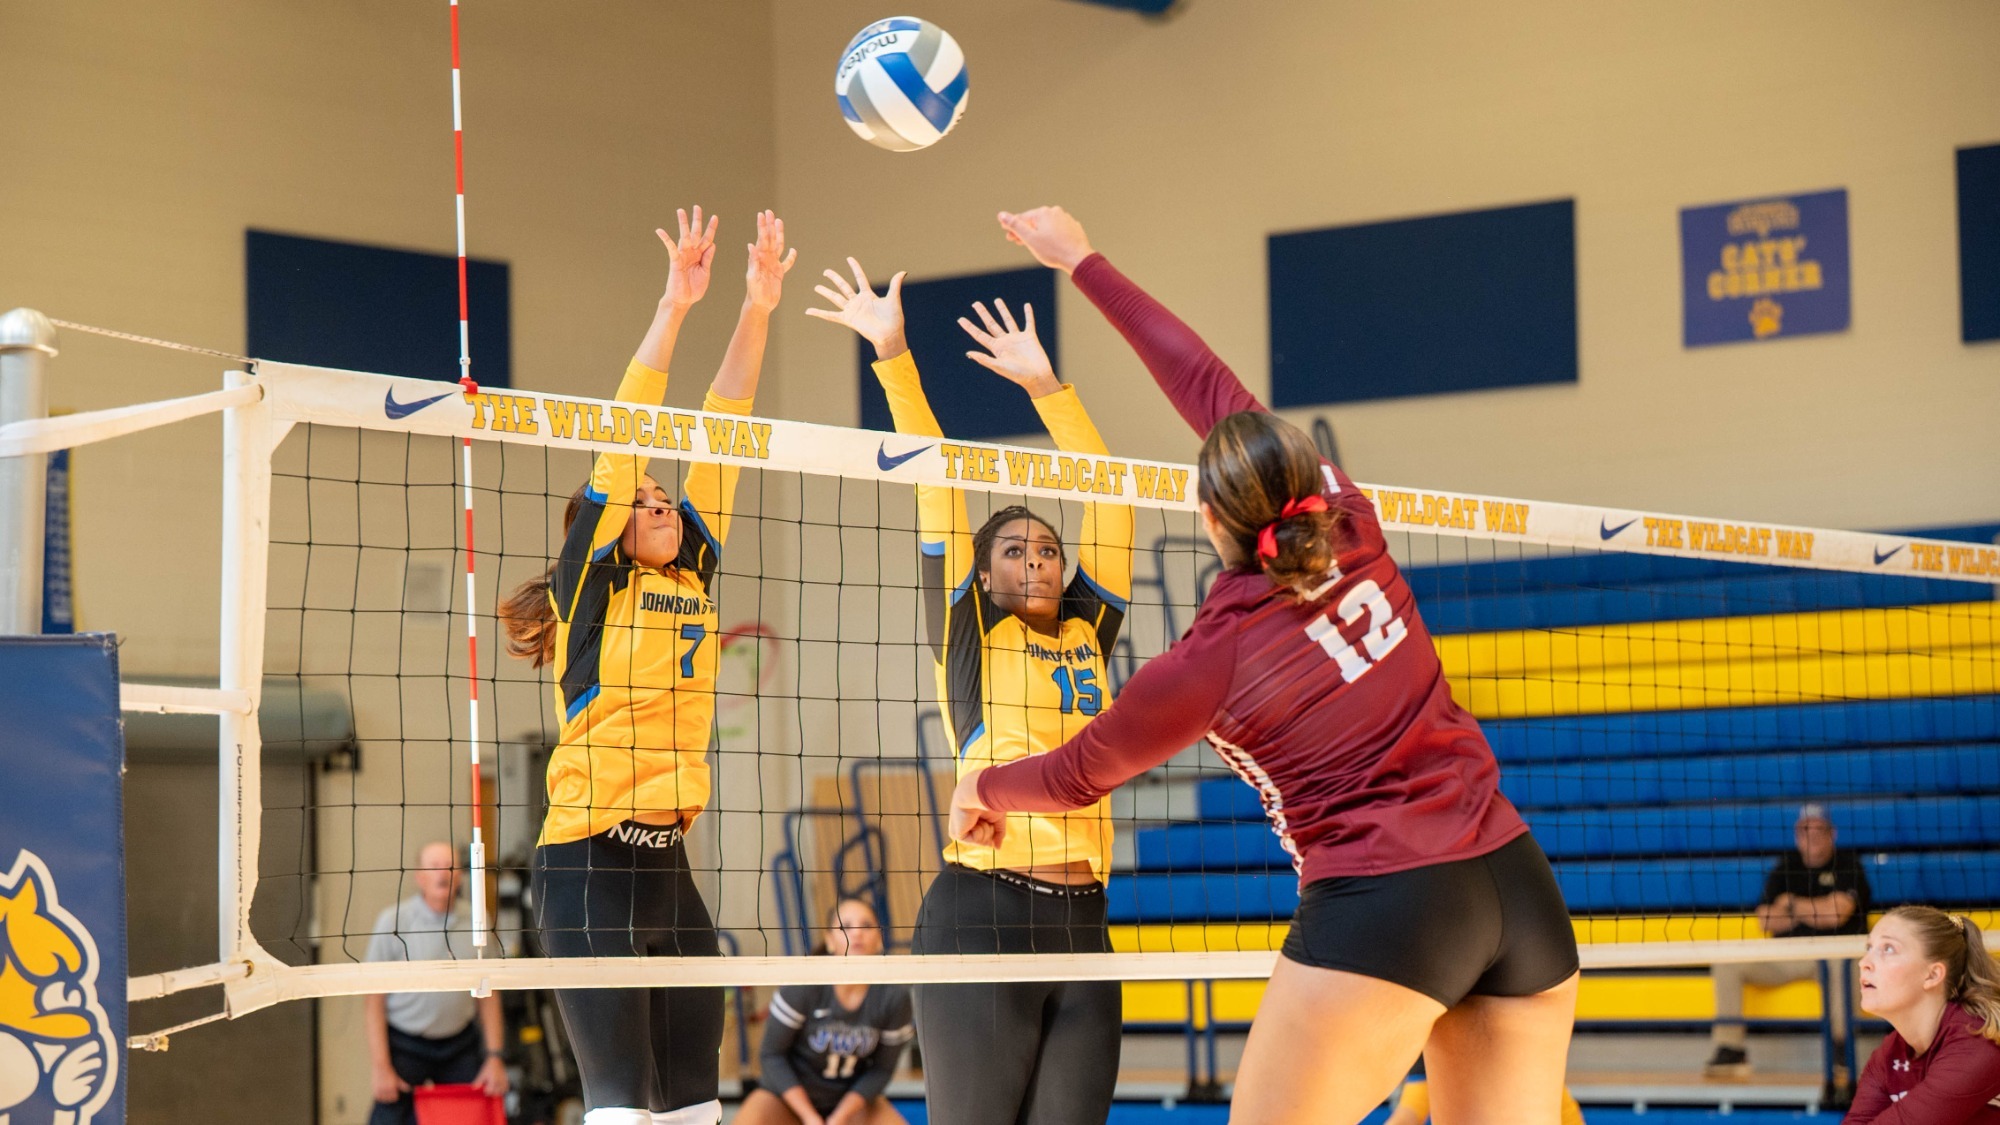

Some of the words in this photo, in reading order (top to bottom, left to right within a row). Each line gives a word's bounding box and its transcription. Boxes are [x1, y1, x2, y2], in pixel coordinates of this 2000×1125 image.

[839, 33, 898, 79] molten
[463, 391, 539, 435] THE
[543, 399, 696, 451] WILDCAT
[703, 416, 772, 460] WAY
[941, 443, 1000, 483] THE
[1004, 450, 1127, 496] WILDCAT
[1132, 464, 1189, 502] WAY
[1378, 489, 1479, 531] WILDCAT
[1483, 500, 1530, 534] WAY
[1643, 516, 1683, 549] THE
[1686, 520, 1772, 557] WILDCAT
[1775, 529, 1815, 561] WAY
[1909, 542, 1944, 572] THE
[1947, 545, 2000, 577] WILDC
[640, 591, 700, 616] JOHNSON
[680, 623, 706, 678] 7
[1304, 579, 1408, 684] 12
[1051, 665, 1102, 716] 15
[607, 823, 671, 848] NIKE
[822, 1053, 857, 1079] 11
